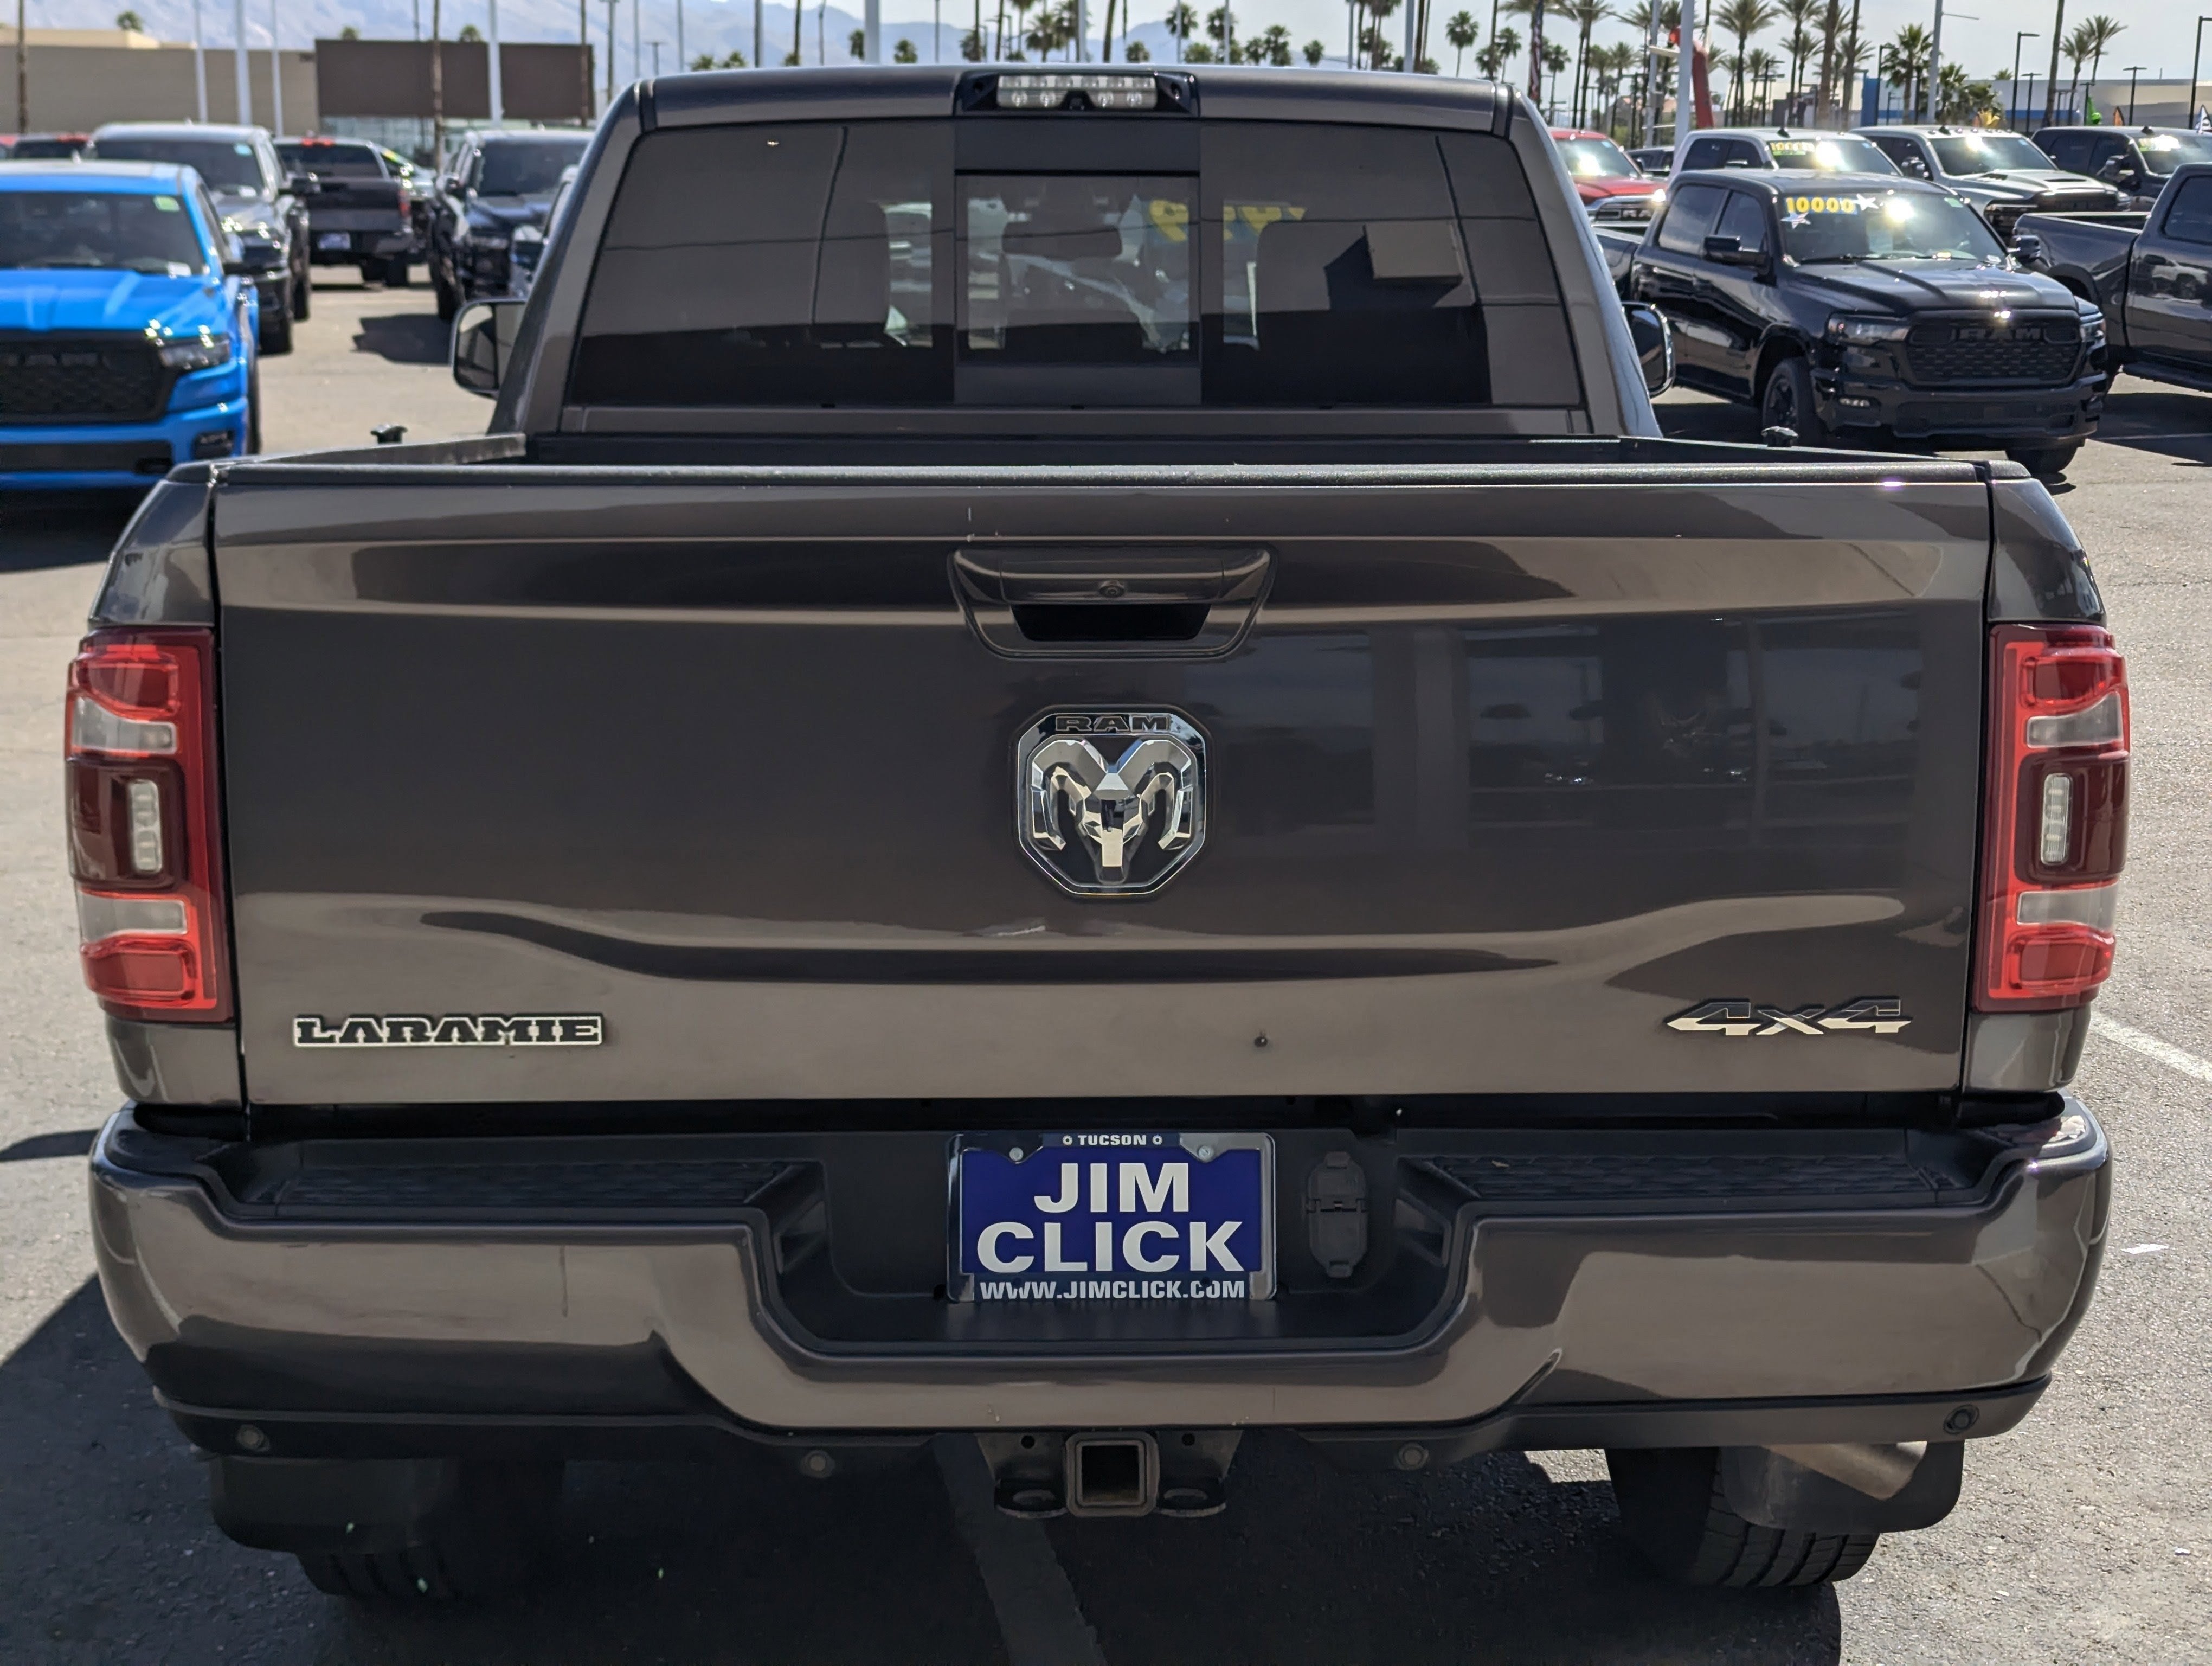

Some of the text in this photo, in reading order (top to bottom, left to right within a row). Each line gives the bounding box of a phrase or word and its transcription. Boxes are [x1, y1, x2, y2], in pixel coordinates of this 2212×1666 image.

[1786, 197, 1855, 214] 10000
[1959, 328, 2041, 340] RAM
[1055, 716, 1169, 732] RAM
[294, 1015, 602, 1047] LARAMIE
[1077, 1134, 1147, 1146] TUCSON
[1033, 1162, 1189, 1213] JIM
[976, 1221, 1245, 1273] CLICK
[979, 1280, 1245, 1300] WWW.JIMCLICK.COM
